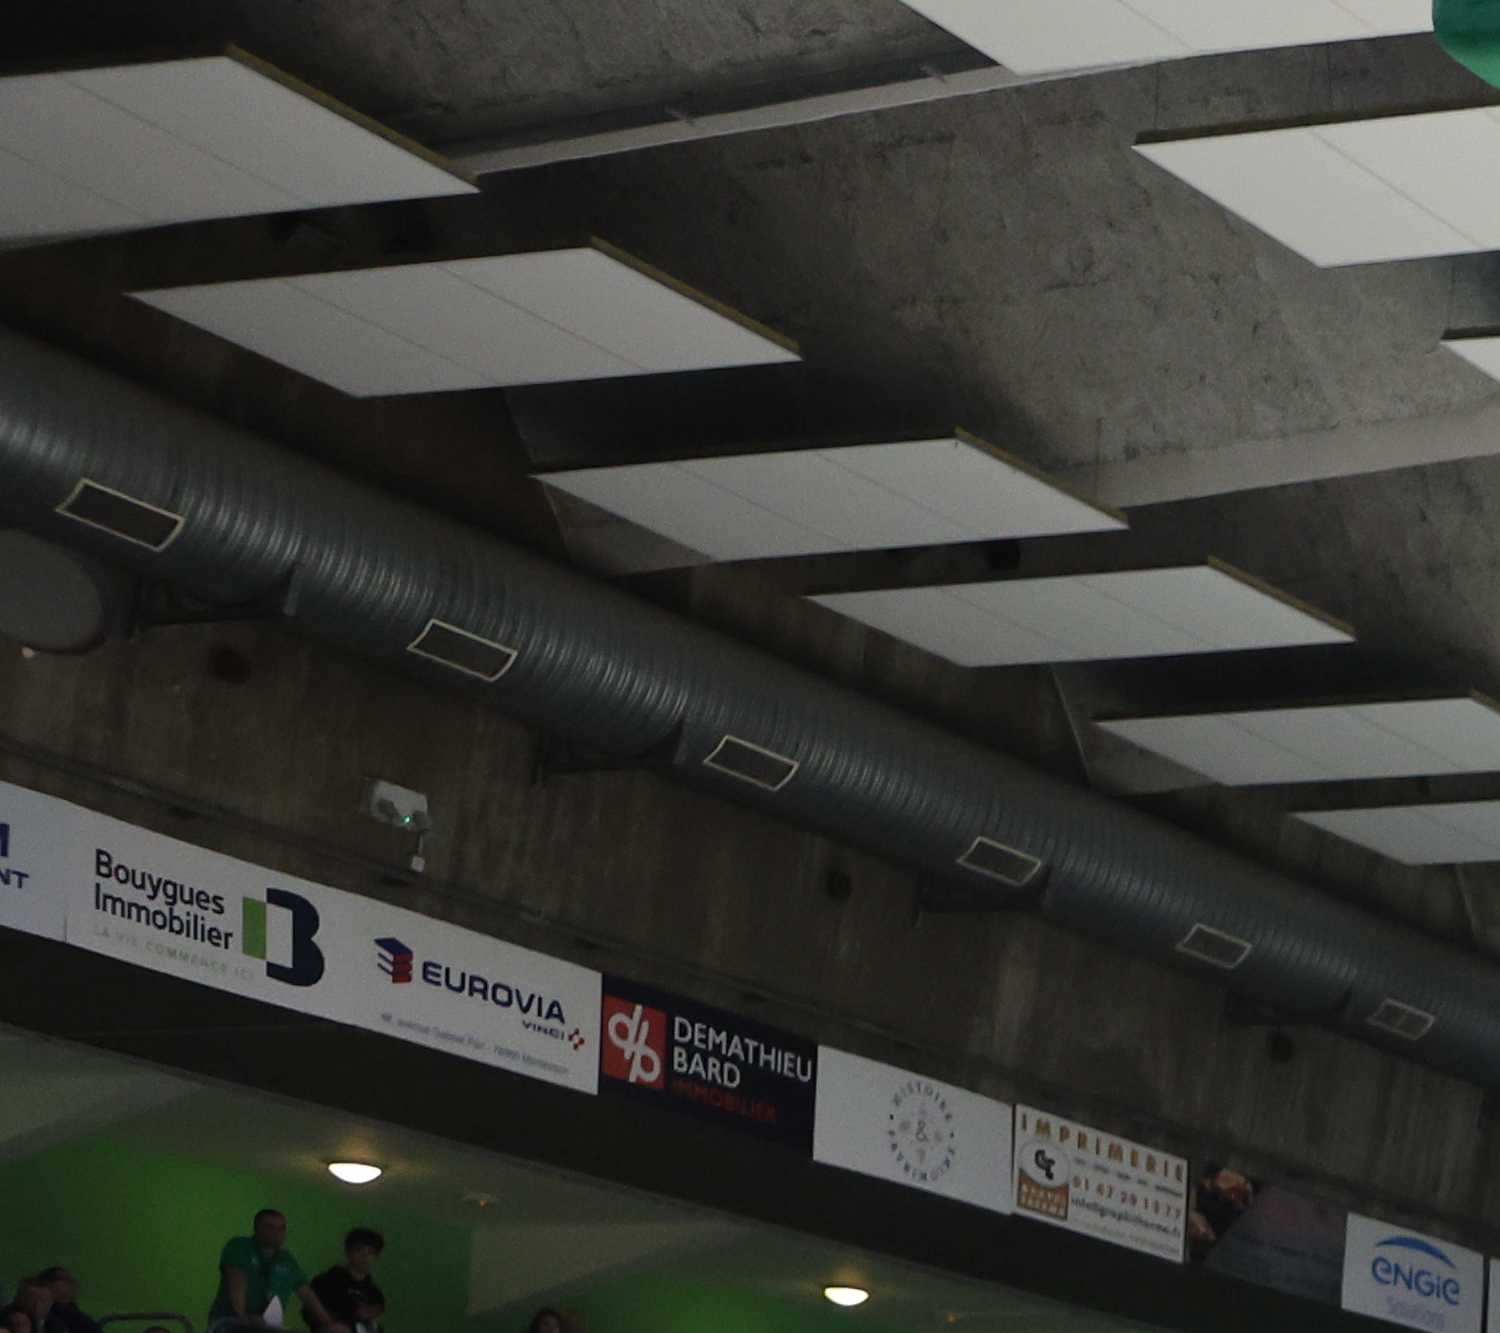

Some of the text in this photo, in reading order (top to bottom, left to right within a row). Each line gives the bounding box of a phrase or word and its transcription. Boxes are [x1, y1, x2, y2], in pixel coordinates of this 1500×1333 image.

[96, 849, 225, 914] Bouygues
[95, 882, 233, 950] Immobilier
[422, 961, 566, 1024] EUROVIA
[521, 1019, 565, 1041] VINCI
[673, 1015, 812, 1083] DEMATHIEU
[673, 1045, 740, 1088] BARD
[1021, 1112, 1184, 1183] IMPRIMERIE
